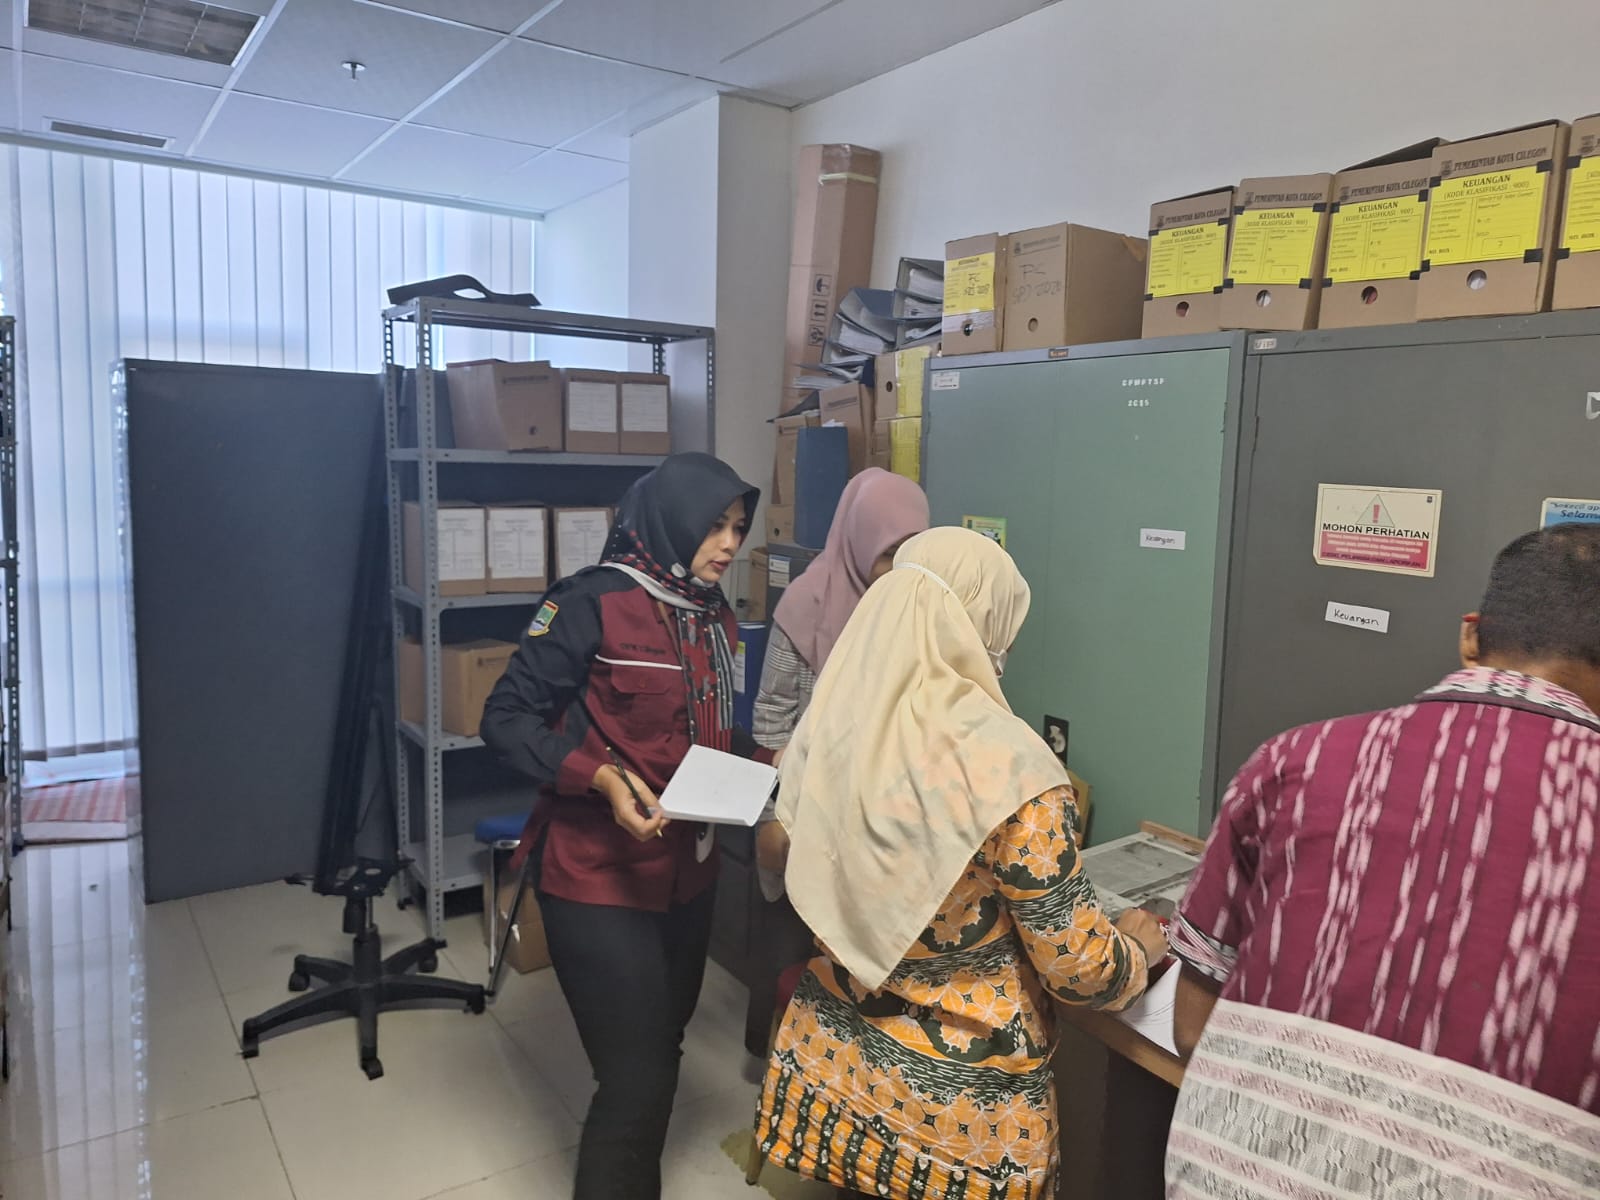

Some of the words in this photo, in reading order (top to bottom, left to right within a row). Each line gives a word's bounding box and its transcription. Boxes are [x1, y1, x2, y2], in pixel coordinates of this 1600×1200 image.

[1515, 147, 1547, 160] CILEGON
[1462, 174, 1512, 188] KEUANGAN
[1358, 201, 1399, 213] KEUANGAN
[1258, 212, 1295, 220] KEUANGAN
[1172, 227, 1204, 237] KEUANGAN
[1322, 523, 1363, 534] MOHON
[1365, 526, 1430, 539] PERHATIAN
[1334, 608, 1379, 626] Keuangan
